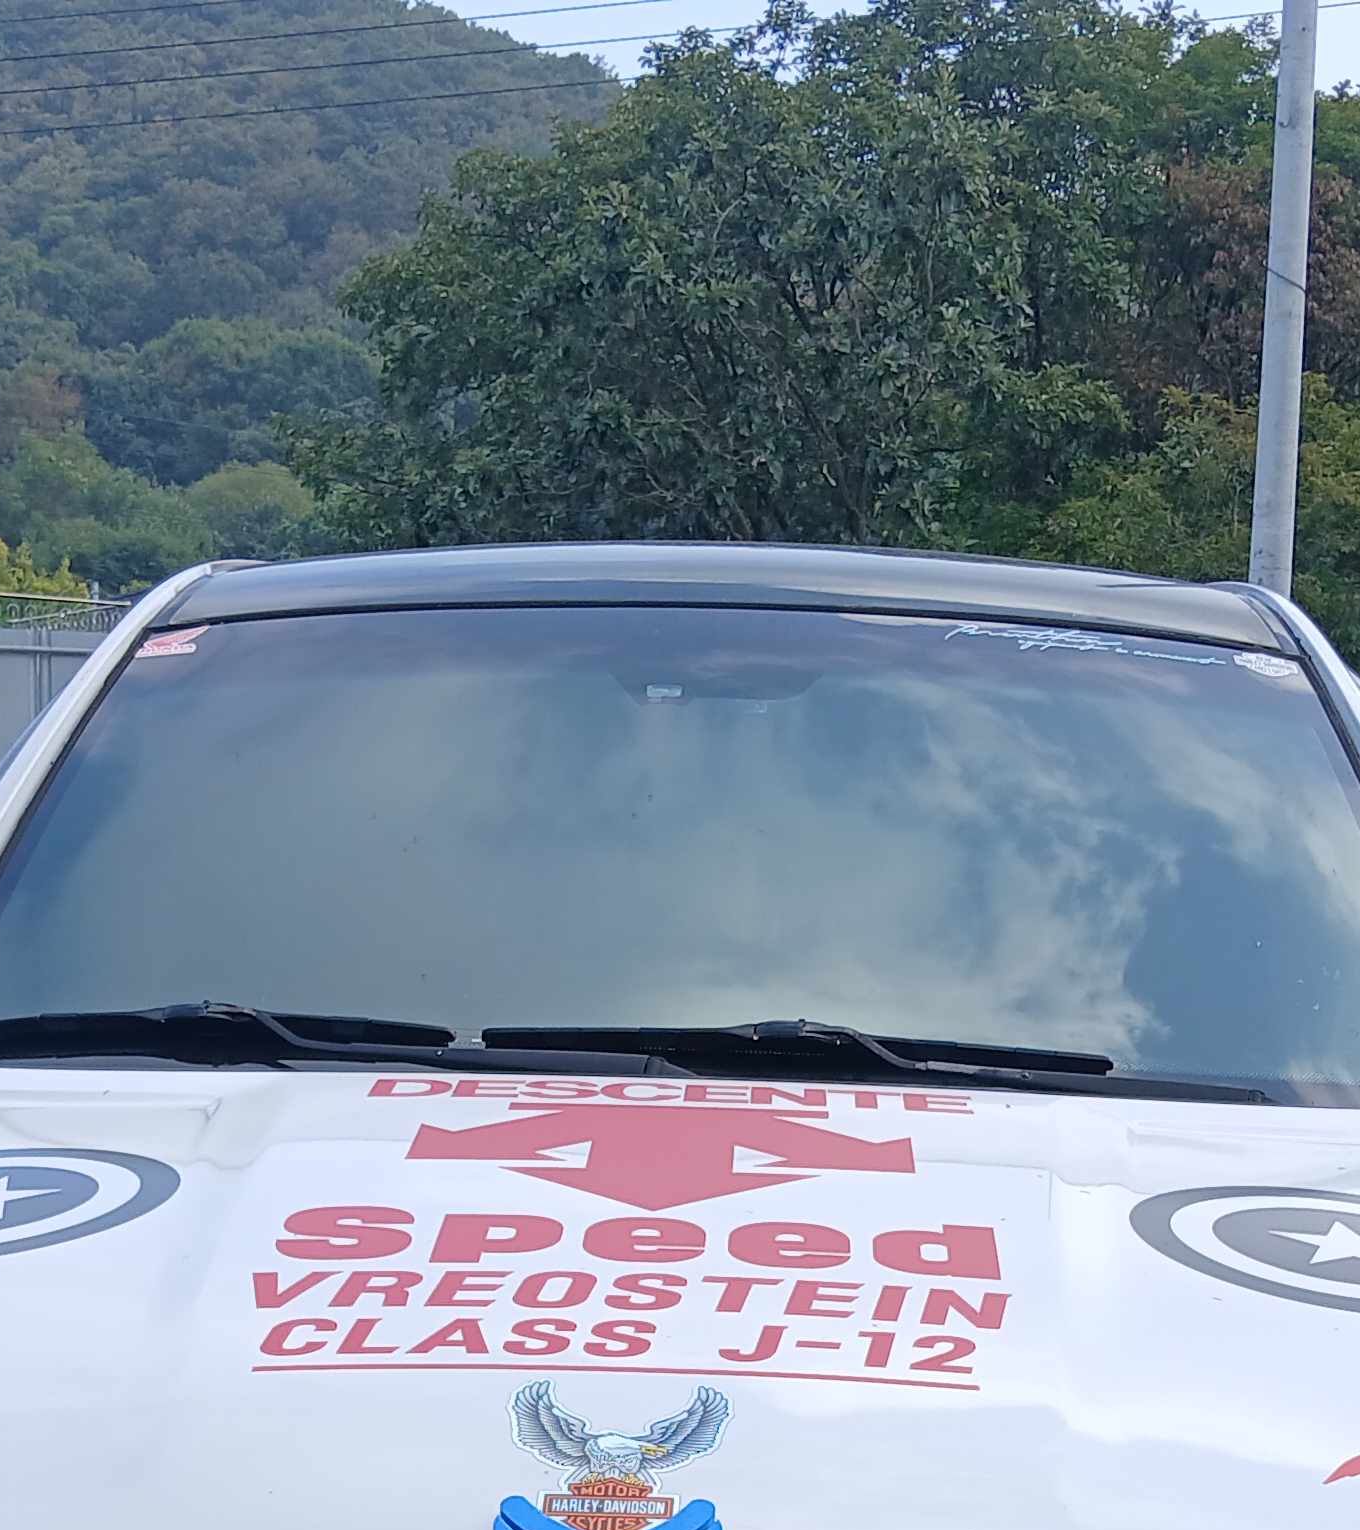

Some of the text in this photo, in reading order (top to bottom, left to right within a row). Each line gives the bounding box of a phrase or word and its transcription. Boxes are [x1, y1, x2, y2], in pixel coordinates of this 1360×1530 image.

[368, 1078, 975, 1113] DESCENTE
[276, 1205, 1002, 1281] Speed
[252, 1270, 1012, 1330] VREOSTEIN
[259, 1317, 978, 1375] CLASS J-12
[551, 1498, 666, 1515] HARLEY-DAVIDSON
[580, 1482, 641, 1497] MOTOR
